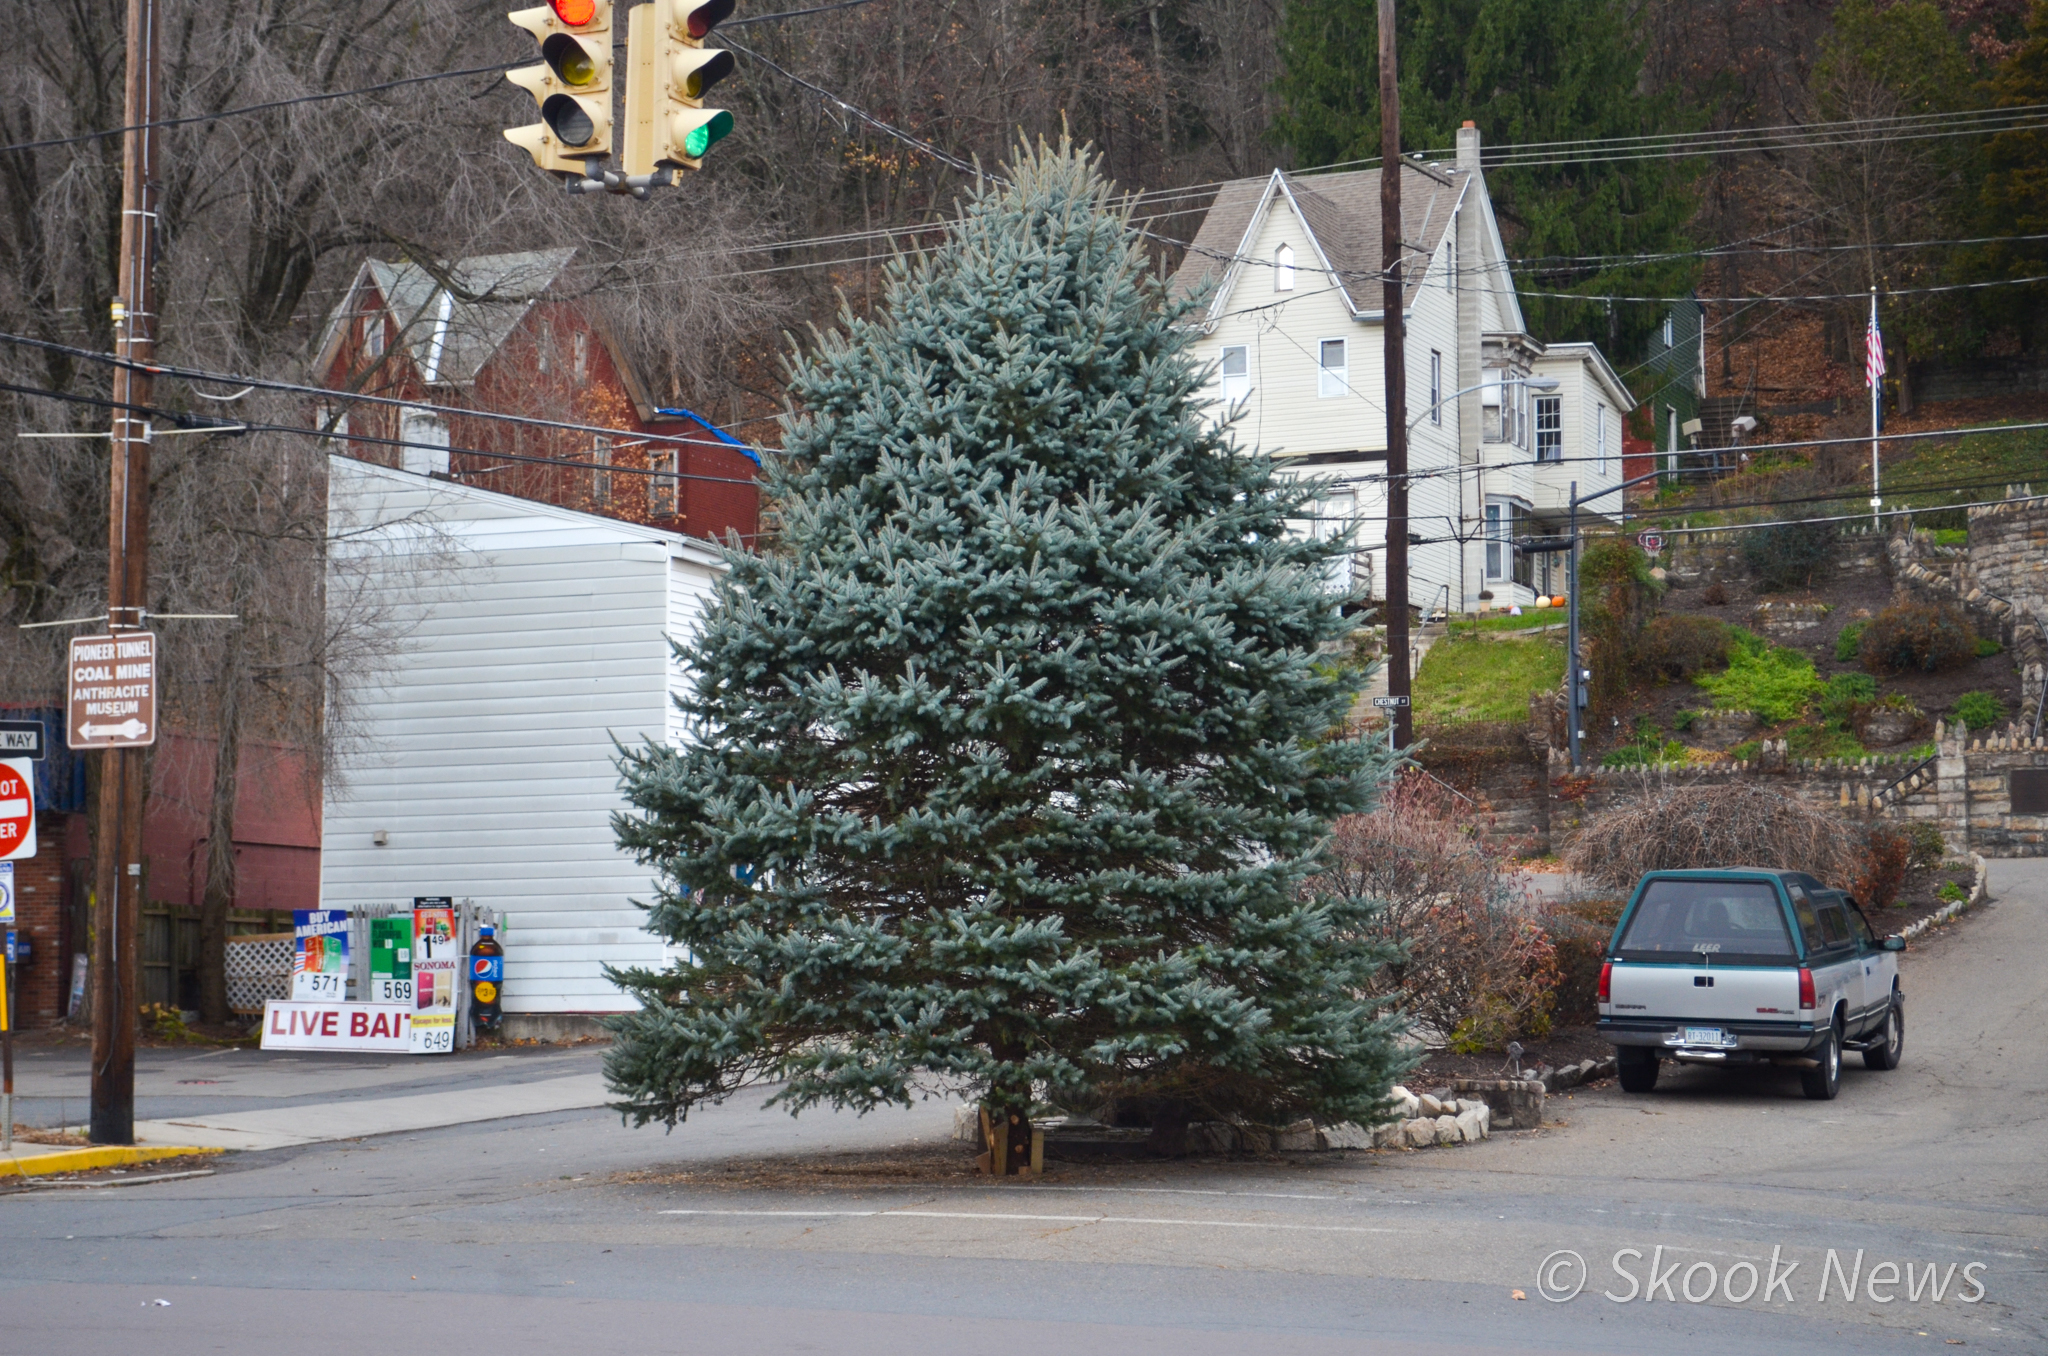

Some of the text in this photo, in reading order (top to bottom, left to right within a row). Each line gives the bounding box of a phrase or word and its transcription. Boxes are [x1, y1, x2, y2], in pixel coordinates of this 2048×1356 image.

[73, 640, 151, 662] PIONEER TUNNEL
[74, 663, 151, 682] COAL MINE
[73, 684, 149, 700] ANTHRACITE
[86, 701, 139, 715] MUSEUM
[1374, 697, 1400, 705] CHESTNUT
[6, 733, 33, 747] WAY
[309, 910, 331, 924] BUY
[296, 920, 347, 938] AMERICAN
[1692, 943, 1721, 952] LEER
[413, 961, 455, 970] SONOMA
[271, 1010, 339, 1036] LIVE
